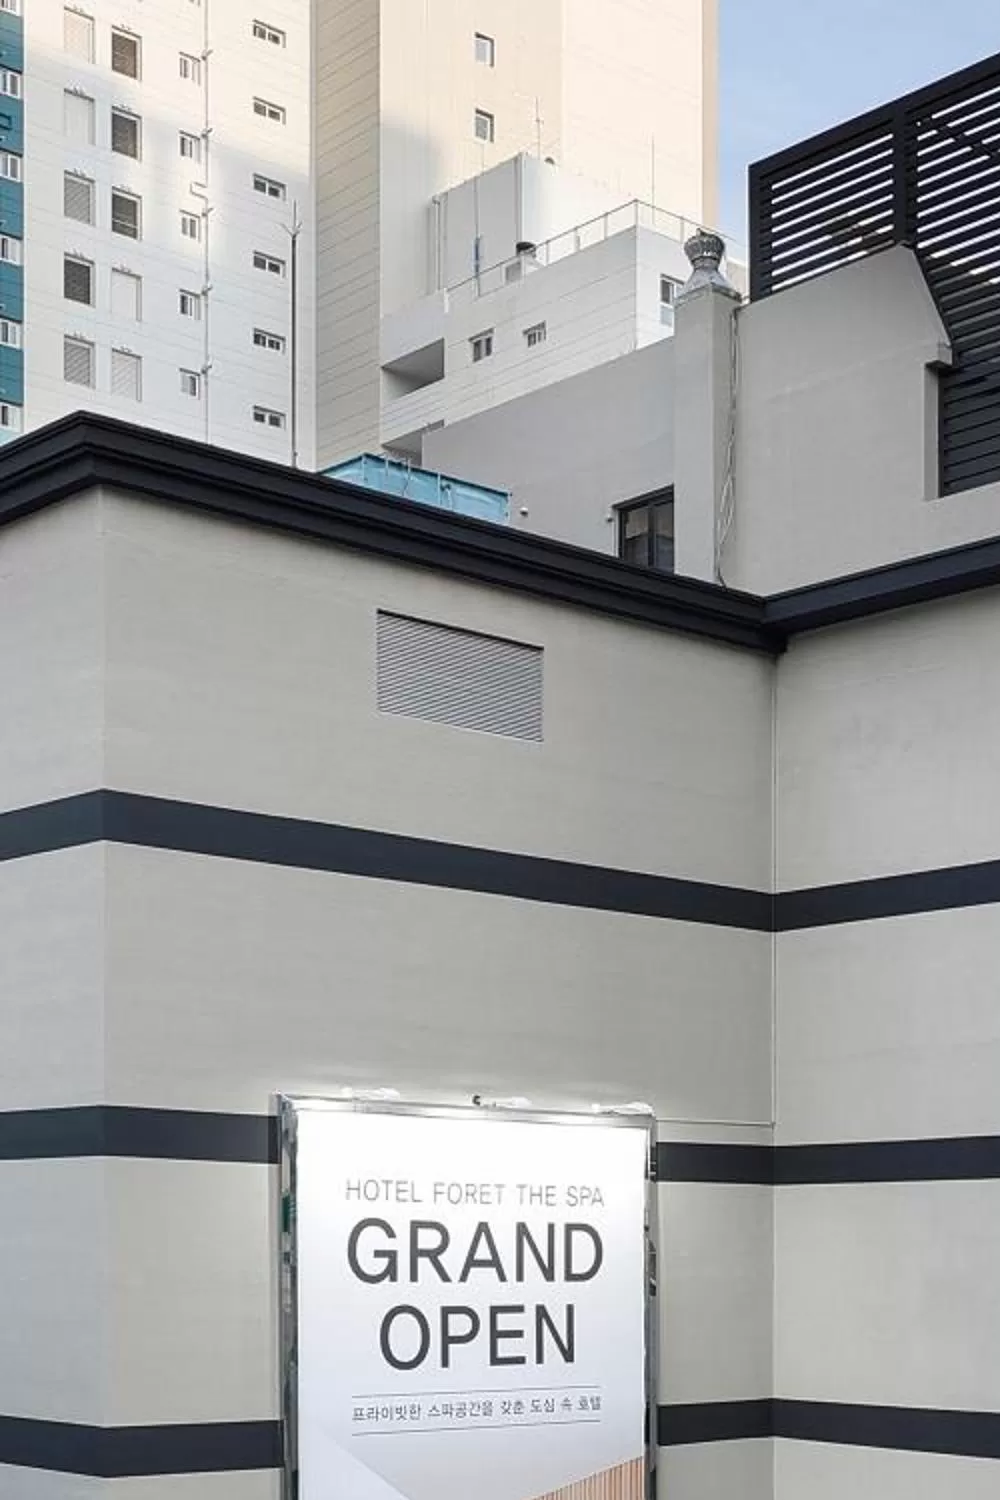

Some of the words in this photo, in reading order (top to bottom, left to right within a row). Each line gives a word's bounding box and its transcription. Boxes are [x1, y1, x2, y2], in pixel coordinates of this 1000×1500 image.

[346, 1179, 423, 1203] HOTEL
[433, 1182, 506, 1205] FORET
[516, 1184, 557, 1206] THE
[566, 1185, 604, 1206] SPA
[347, 1217, 603, 1284] GRAND
[379, 1303, 575, 1370] OPEN
[351, 1403, 421, 1422] 프라이빗한
[530, 1397, 555, 1413] 도심
